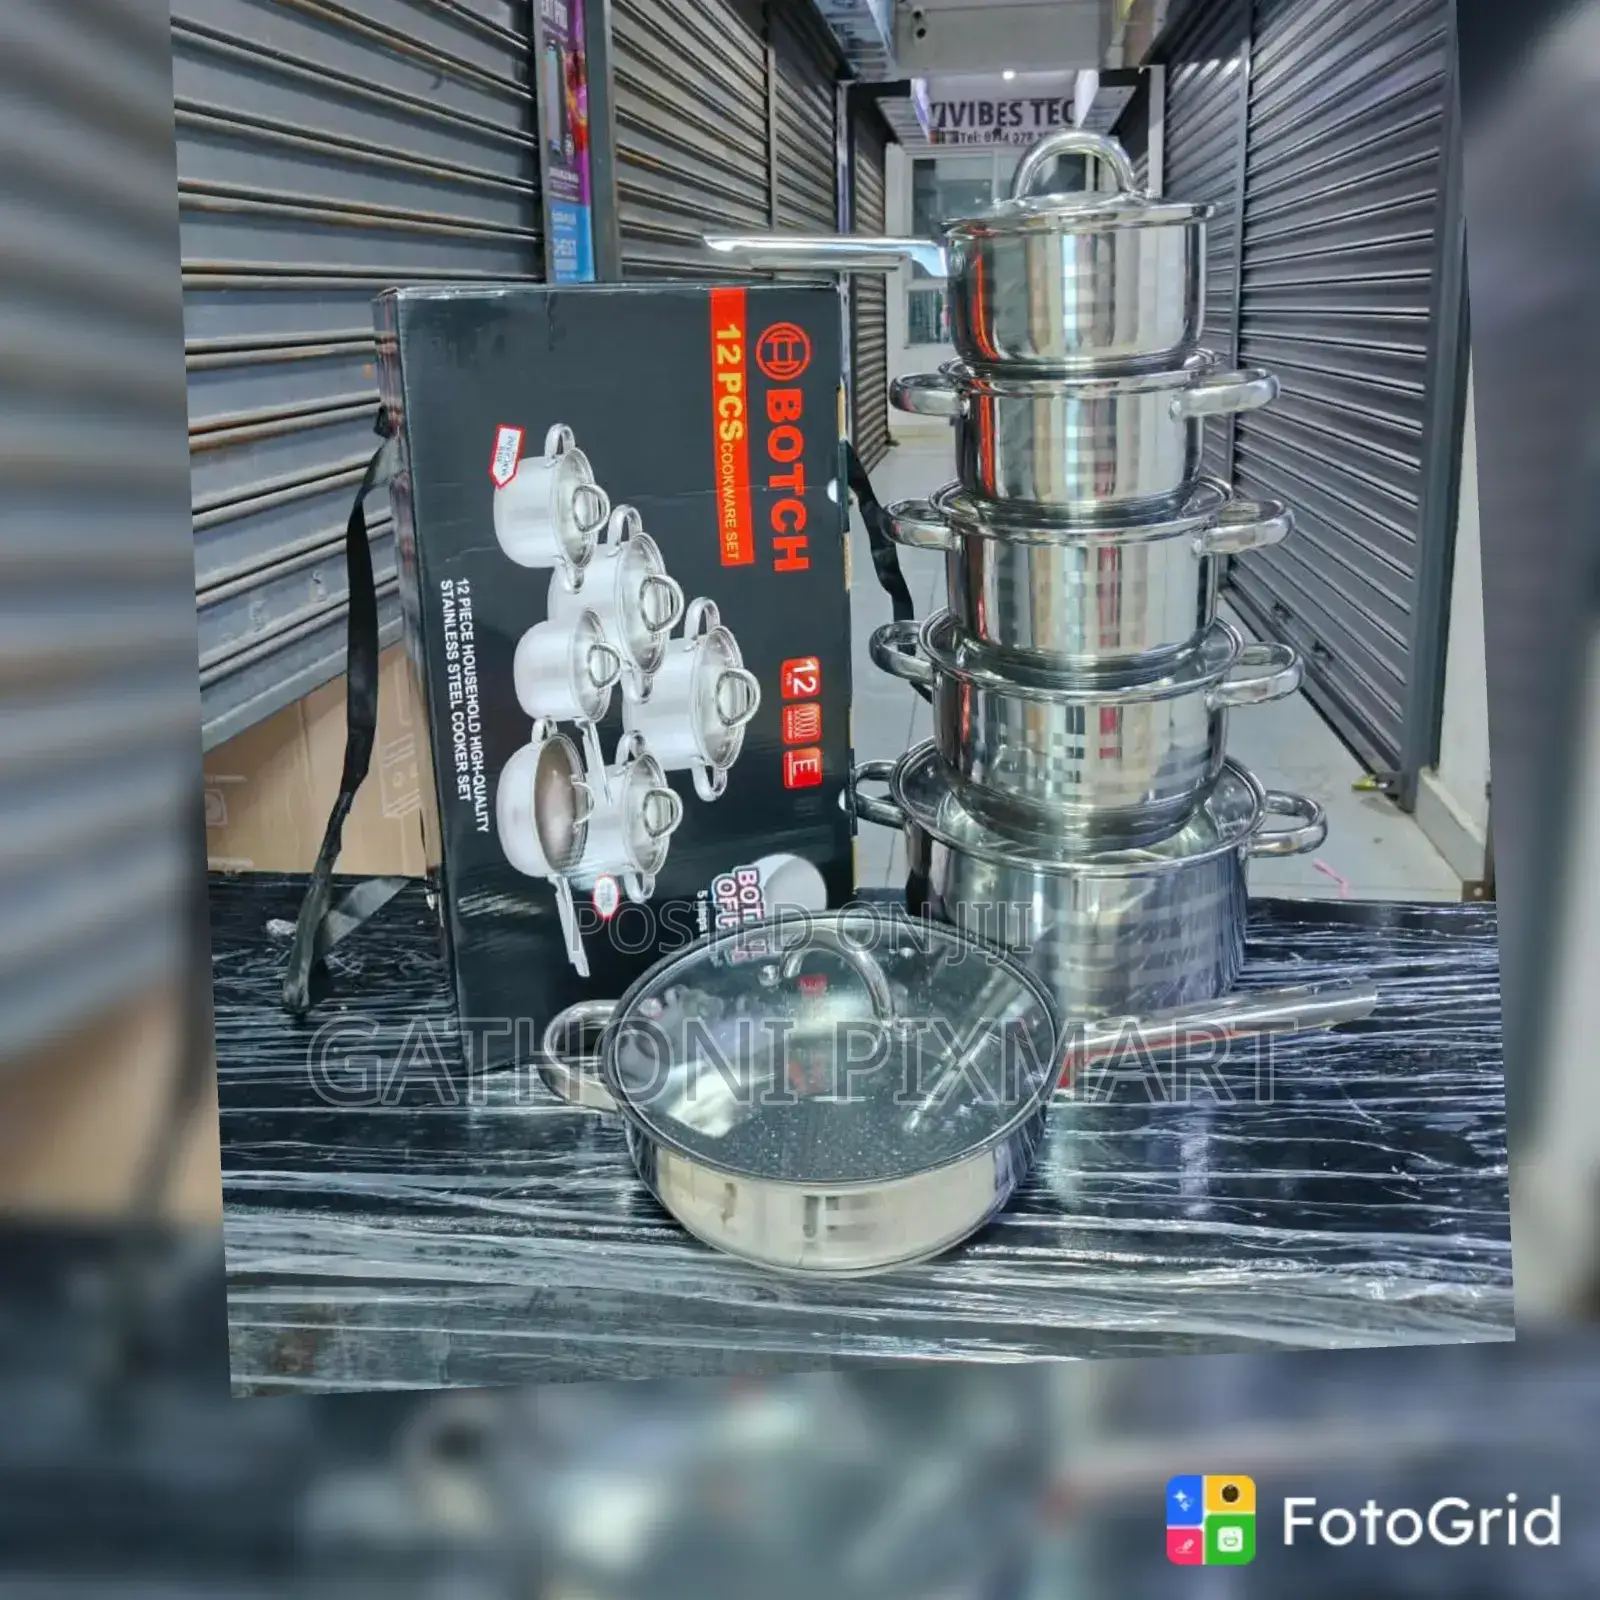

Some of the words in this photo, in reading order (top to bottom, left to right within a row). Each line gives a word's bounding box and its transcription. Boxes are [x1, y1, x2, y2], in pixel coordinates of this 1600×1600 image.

[715, 323, 742, 366] 12
[717, 372, 744, 442] PCS
[720, 441, 738, 529] COOKWARE
[766, 387, 810, 572] BOTCH
[725, 531, 741, 560] SET
[457, 577, 471, 596] 12
[440, 578, 460, 661] STAINLESS
[458, 597, 475, 642] PIECE
[447, 663, 464, 710] STEEL
[462, 643, 482, 733] HOUSEHOLD
[792, 659, 817, 696] 12
[451, 711, 469, 773] COOKER
[457, 774, 472, 802] SET
[469, 735, 490, 833] HIGH-QUALITY
